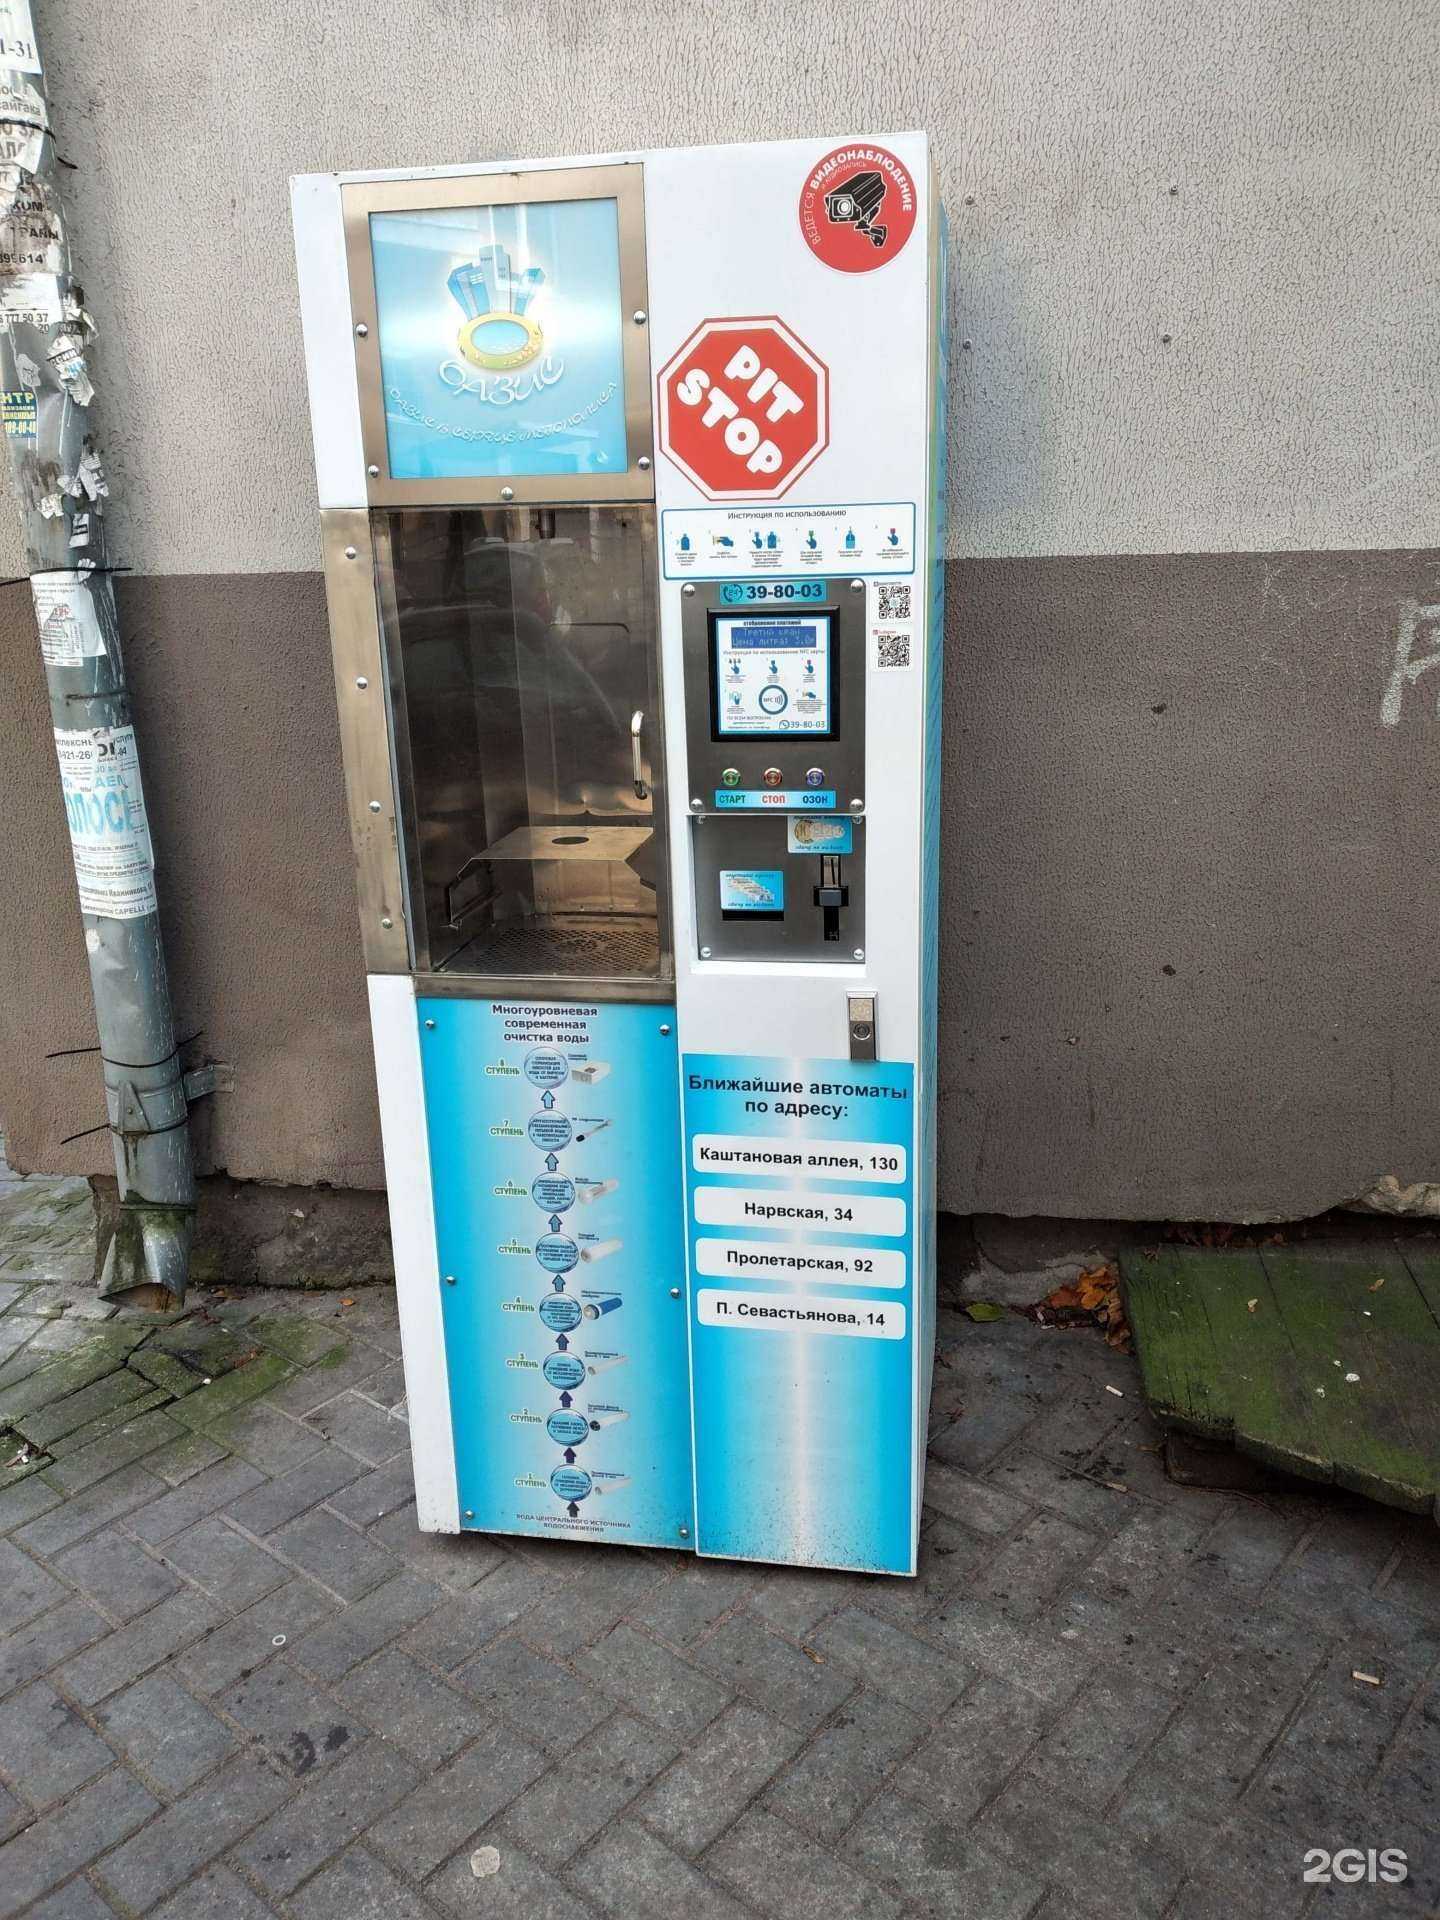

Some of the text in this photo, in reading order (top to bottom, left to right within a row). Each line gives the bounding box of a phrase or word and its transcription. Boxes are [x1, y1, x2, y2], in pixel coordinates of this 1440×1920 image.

[810, 149, 912, 212] ВИДЕОНАБЛЮДЕНИЕ
[723, 344, 805, 424] PIT
[676, 368, 783, 474] STOP
[746, 583, 823, 599] 39-80-03
[719, 794, 829, 804] СТАРТ СТОП ОЗОН
[492, 1004, 598, 1018] Многоуровневая
[504, 1019, 587, 1030] современная
[503, 1032, 590, 1044] очистка воды
[688, 1074, 908, 1100] Ближайшие автоматы
[745, 1101, 849, 1120] по адресу:
[699, 1147, 899, 1171] Каштановая аллея, 130
[744, 1201, 854, 1222] Нарвская, 34
[726, 1250, 874, 1273] Пролетарская, 92
[716, 1301, 886, 1327] П. Севастьянова, 14
